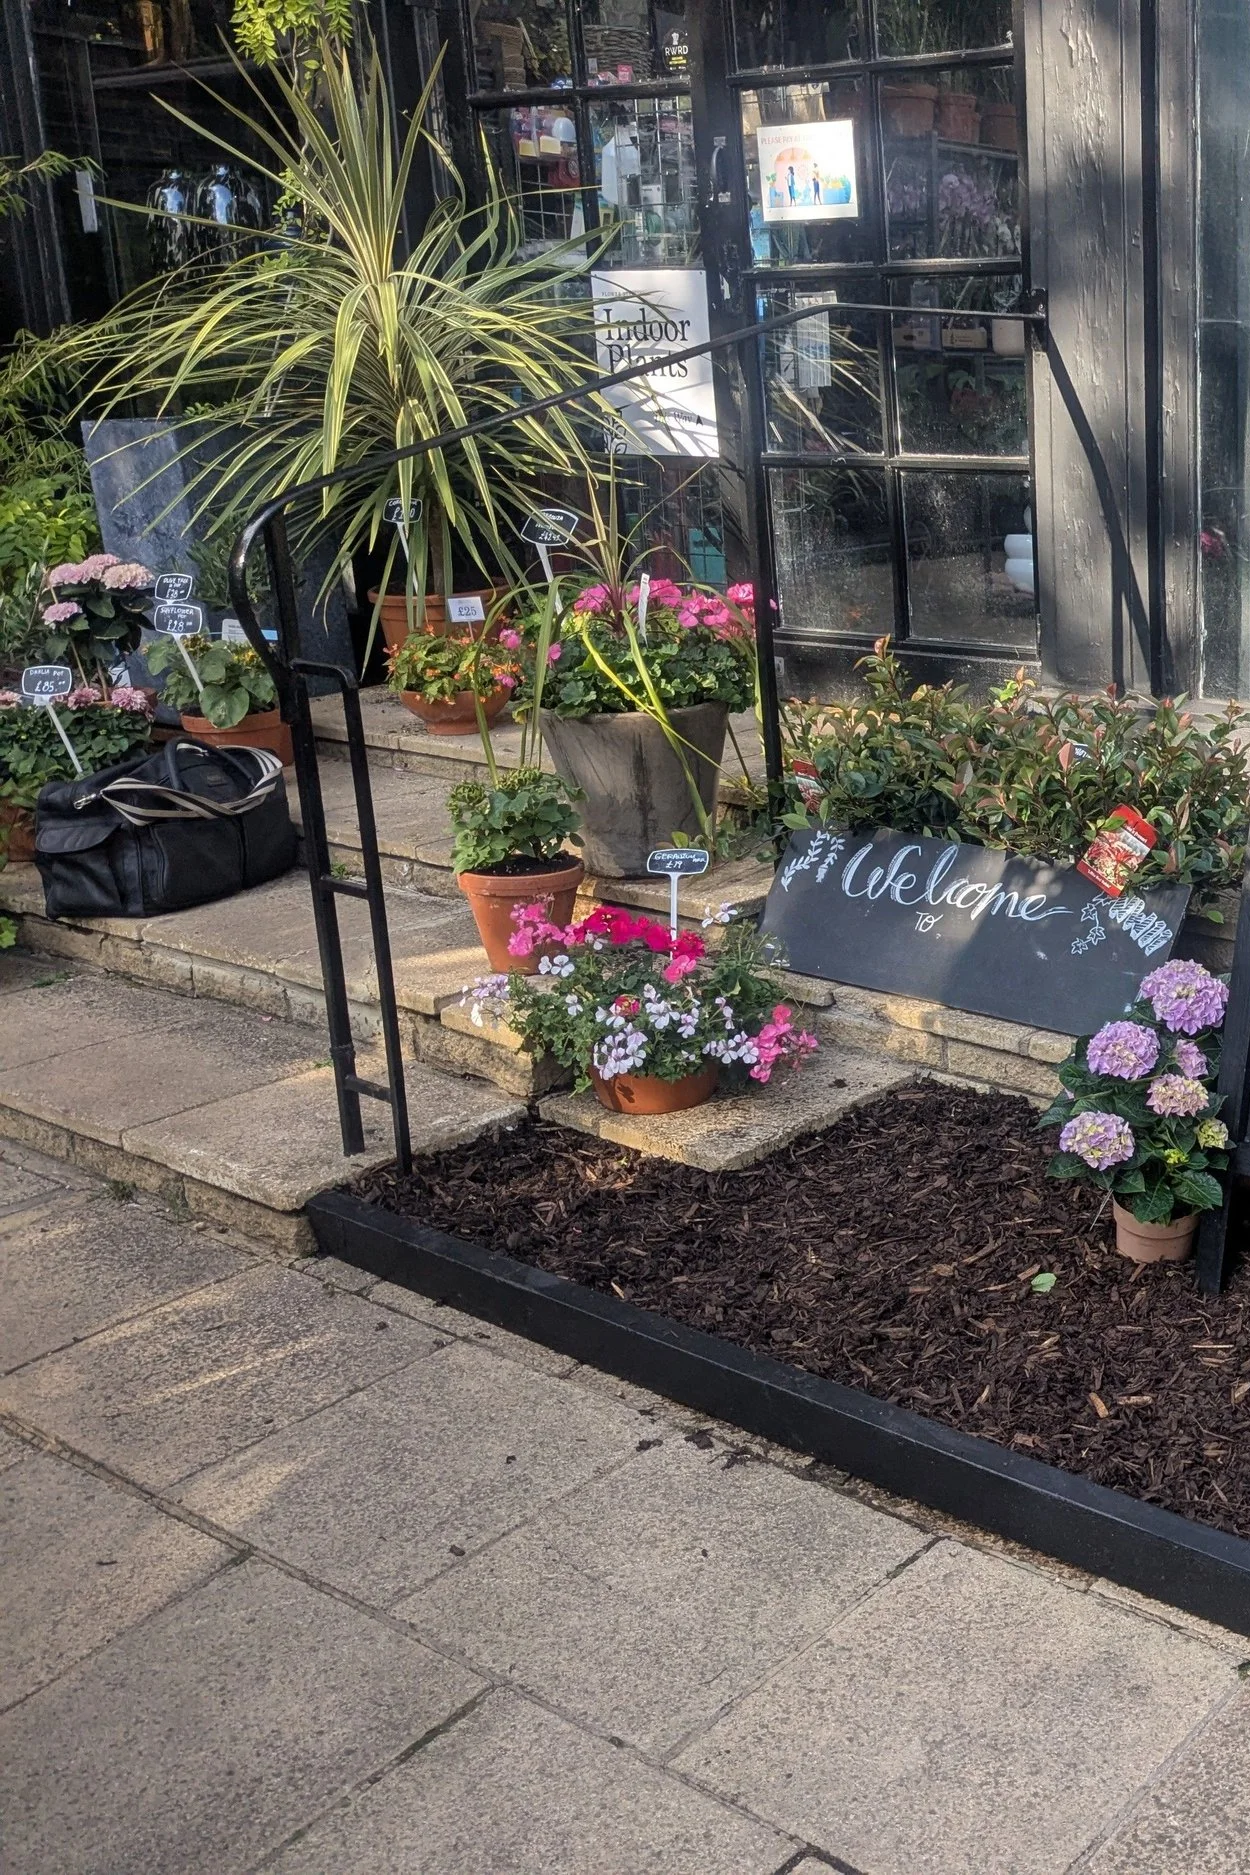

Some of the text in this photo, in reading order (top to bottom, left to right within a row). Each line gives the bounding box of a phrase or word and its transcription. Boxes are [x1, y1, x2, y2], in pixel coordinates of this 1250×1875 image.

[664, 45, 689, 56] RWRD
[603, 307, 691, 342] Indoor
[458, 606, 477, 617] £25
[841, 842, 1074, 922] Welcome
